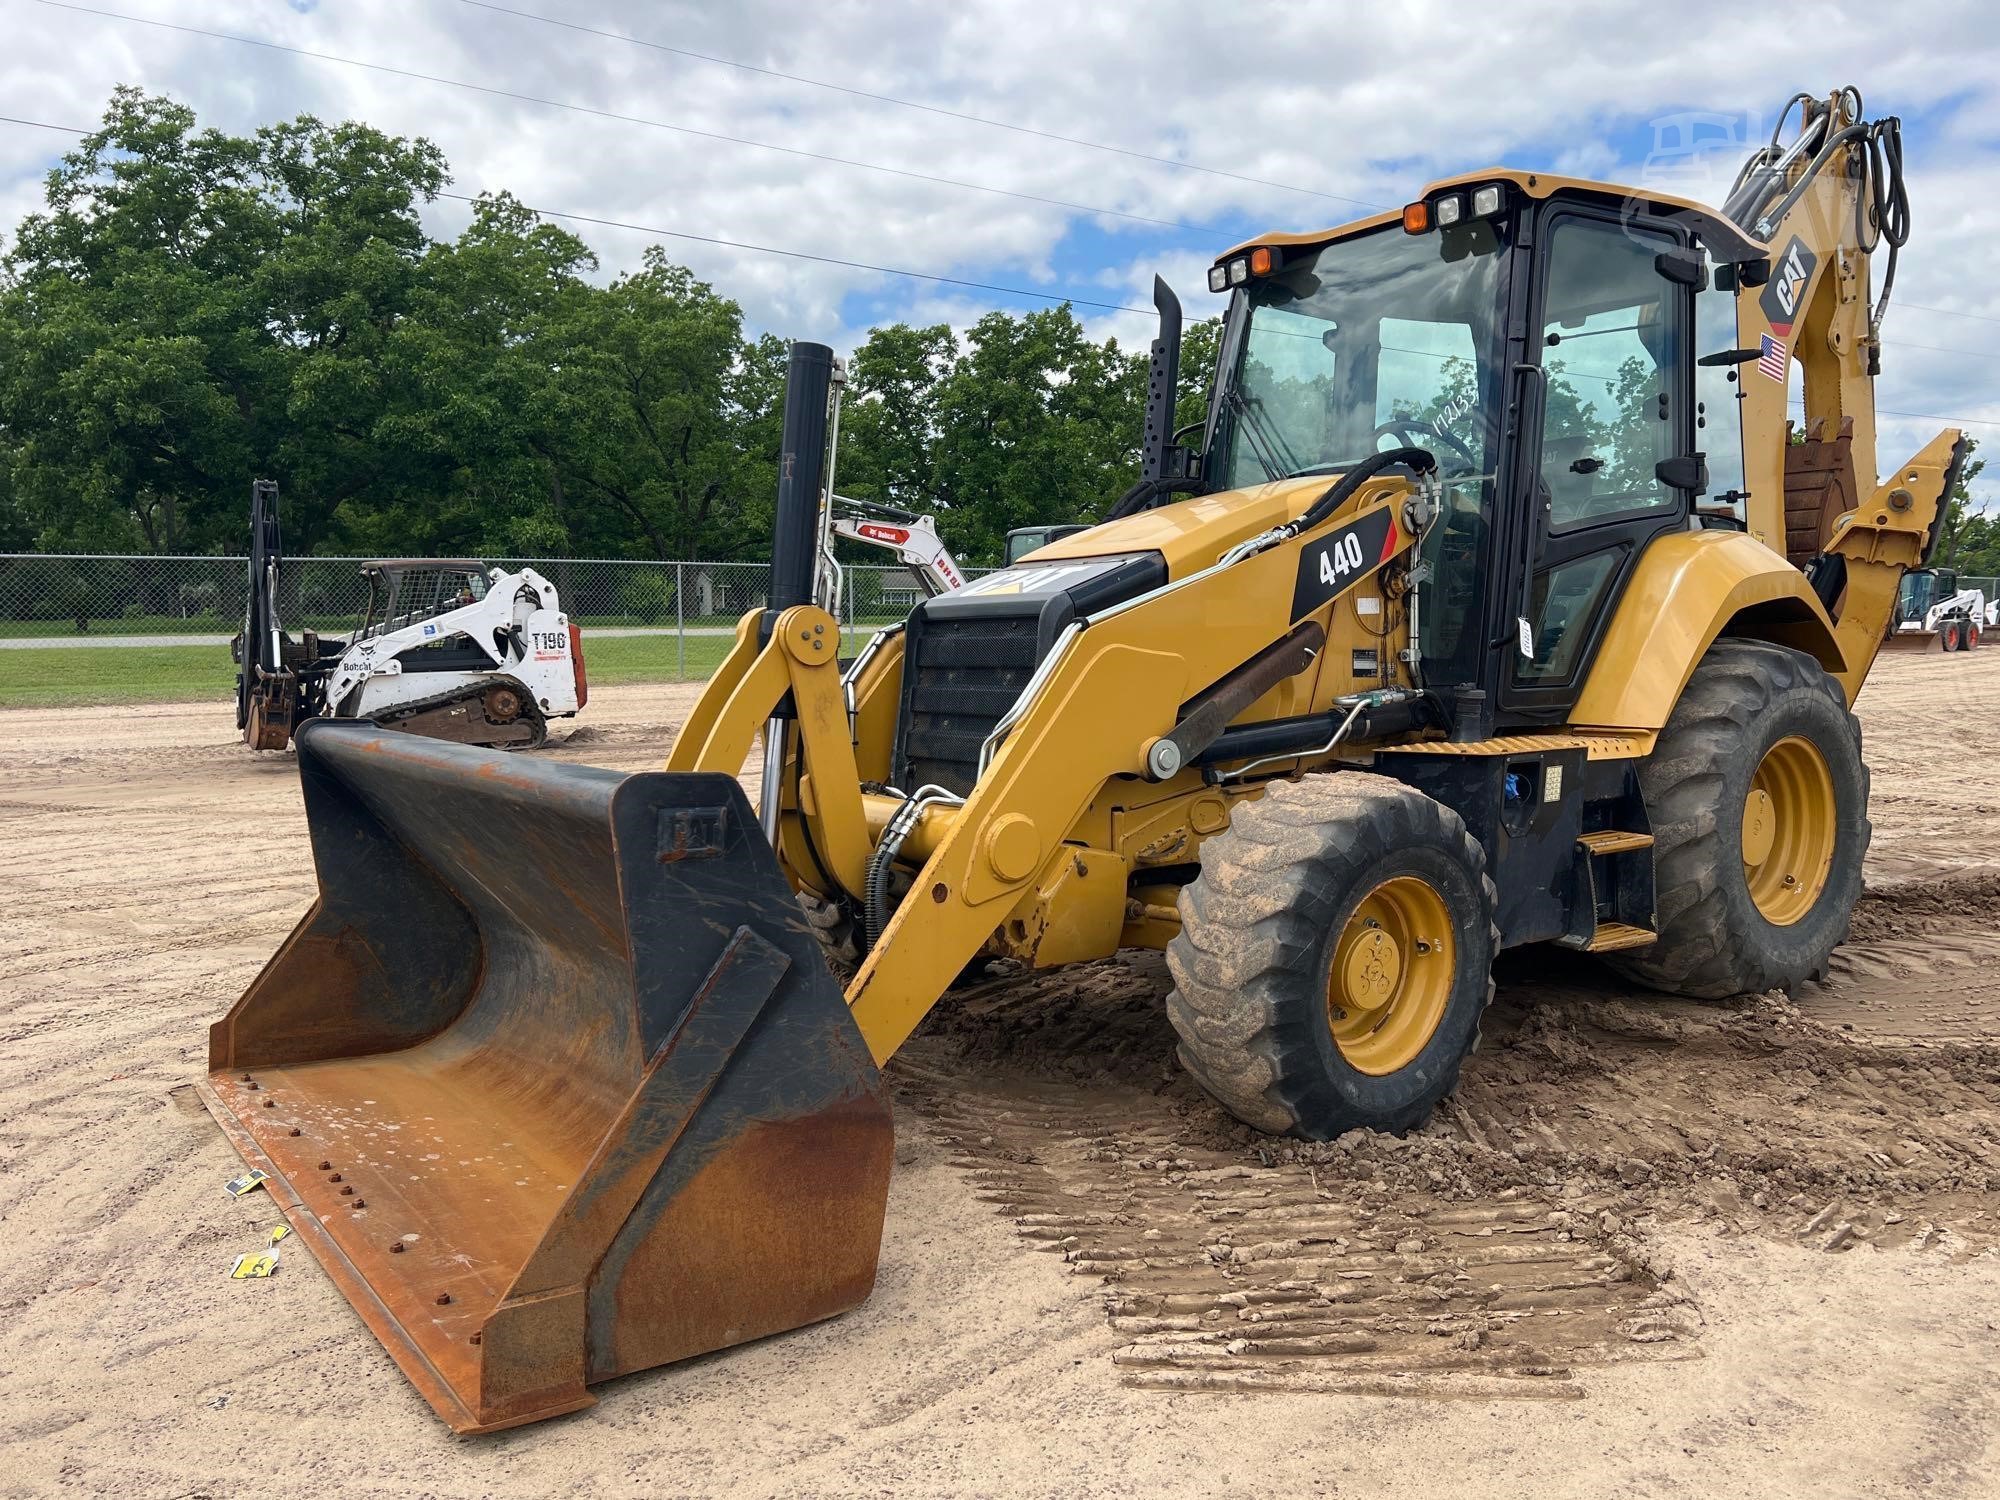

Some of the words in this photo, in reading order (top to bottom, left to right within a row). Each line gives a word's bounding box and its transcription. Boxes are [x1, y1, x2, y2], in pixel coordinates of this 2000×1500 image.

[1776, 243, 1808, 316] CAT
[1432, 389, 1477, 437] 172133
[878, 530, 896, 540] Bobcat
[1319, 532, 1363, 586] 440
